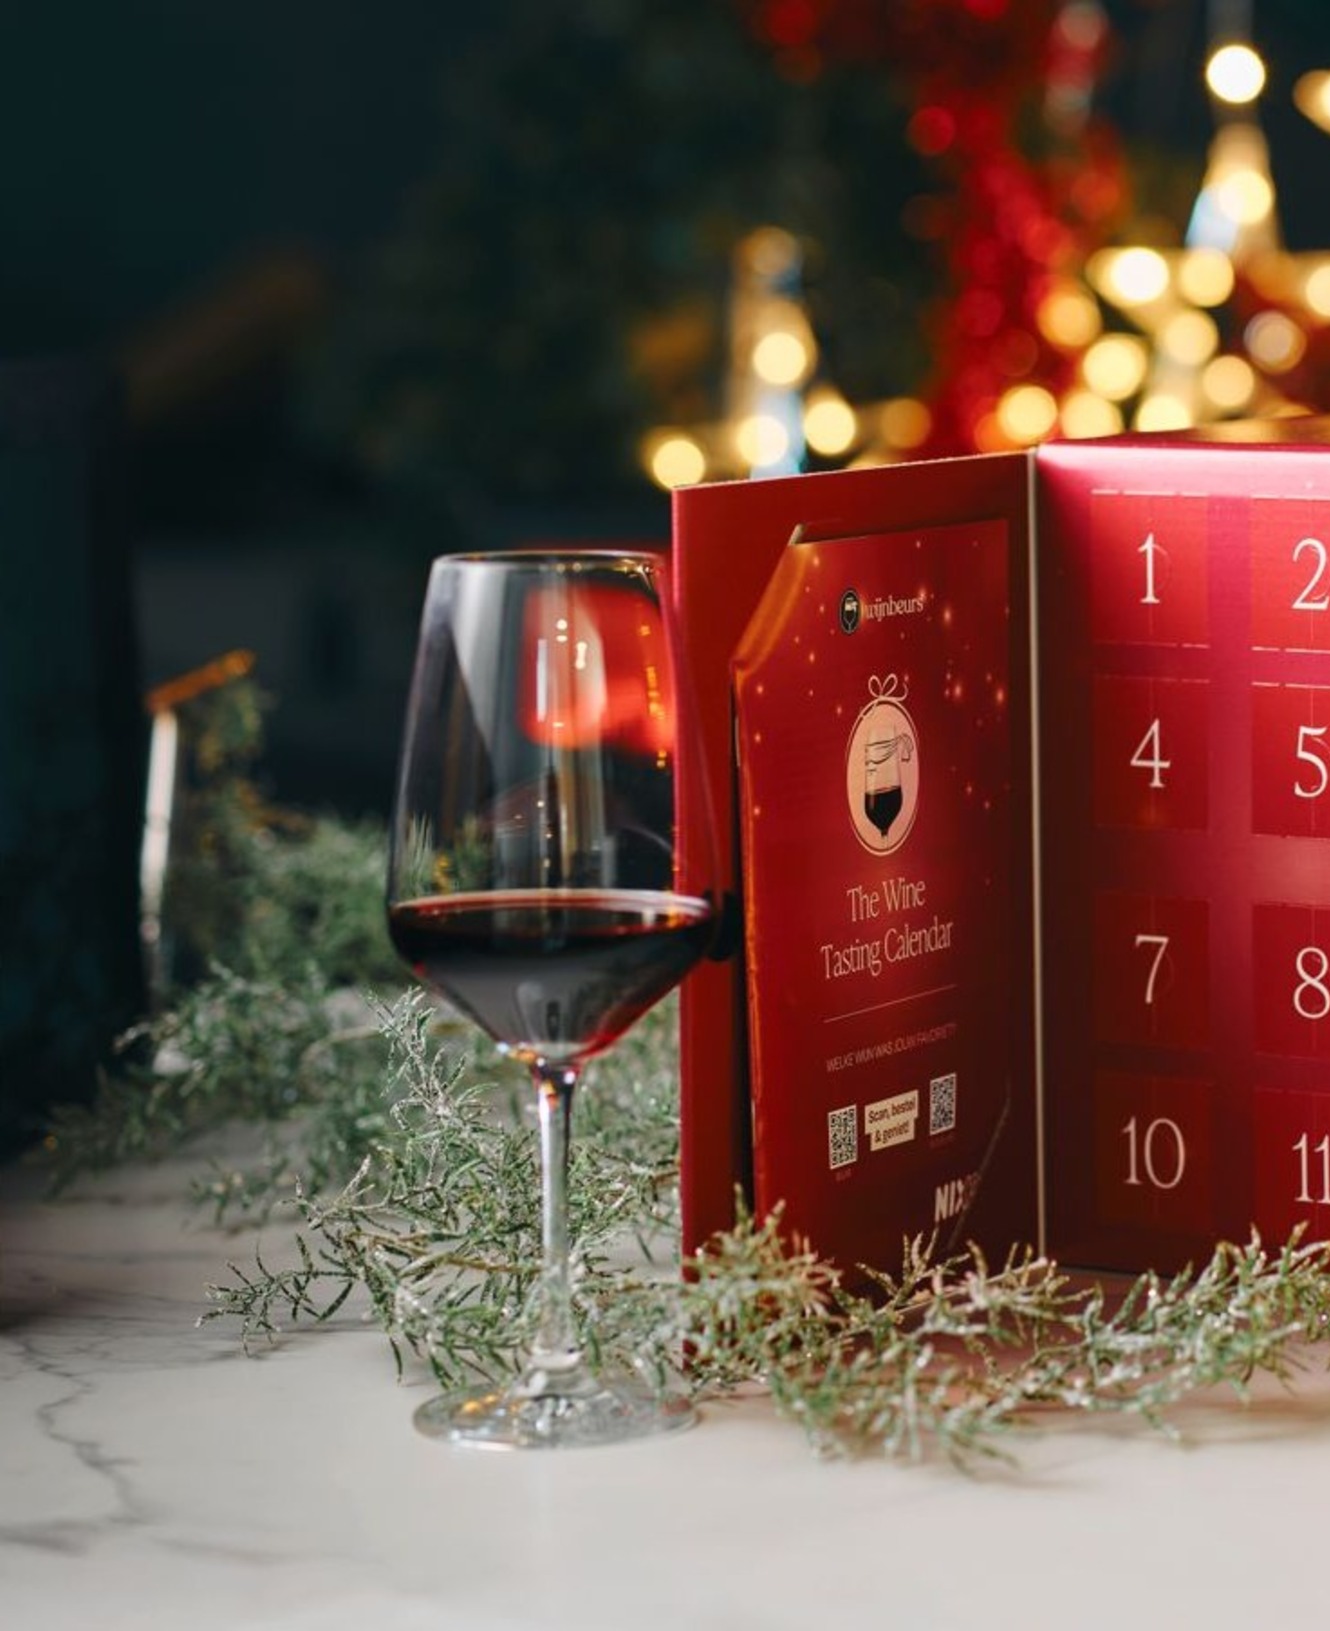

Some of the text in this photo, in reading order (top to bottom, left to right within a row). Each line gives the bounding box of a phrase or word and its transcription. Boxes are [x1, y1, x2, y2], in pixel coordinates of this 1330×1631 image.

[1138, 533, 1160, 604] 1
[1291, 538, 1330, 610] 2
[1130, 719, 1171, 788] 4
[1293, 726, 1329, 798] 5
[846, 877, 926, 922] The Wine
[820, 915, 953, 979] Tasting Calendar
[1135, 935, 1169, 1004] 7
[1293, 947, 1330, 1019] 8
[1121, 1116, 1185, 1189] 10
